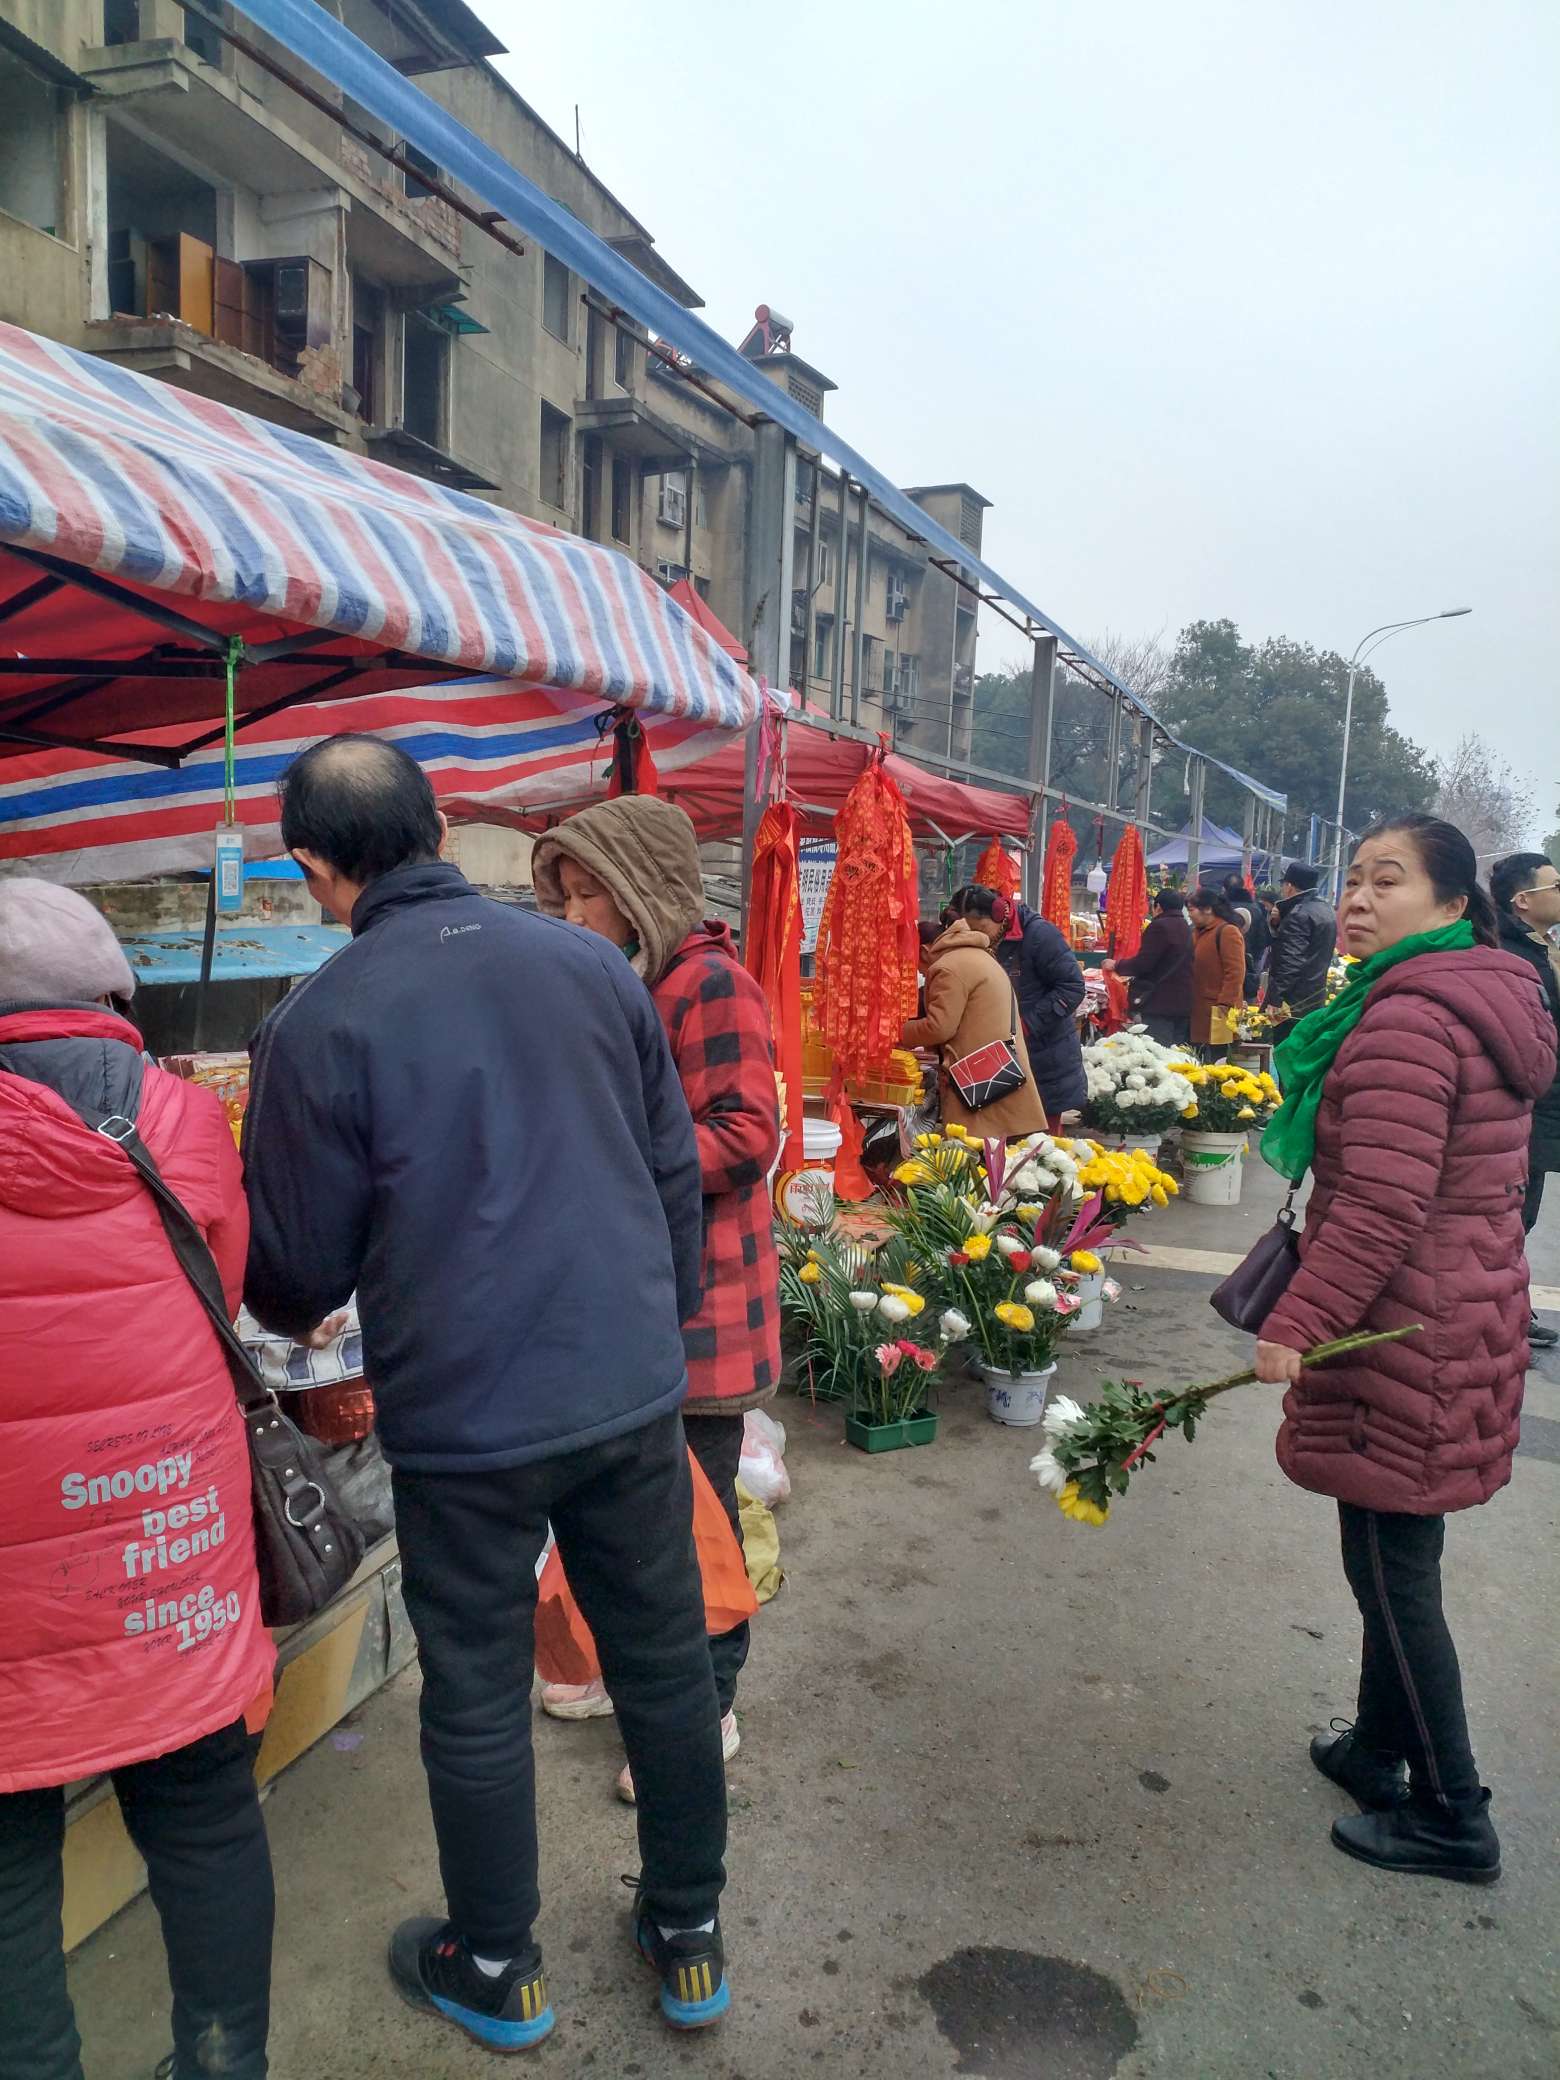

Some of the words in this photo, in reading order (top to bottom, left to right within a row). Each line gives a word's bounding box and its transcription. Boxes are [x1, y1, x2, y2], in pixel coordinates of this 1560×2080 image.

[61, 1451, 192, 1510] Snoopy
[141, 1485, 220, 1537] best
[122, 1512, 226, 1578] friend
[123, 1585, 216, 1637] since
[176, 1591, 241, 1651] 1950
